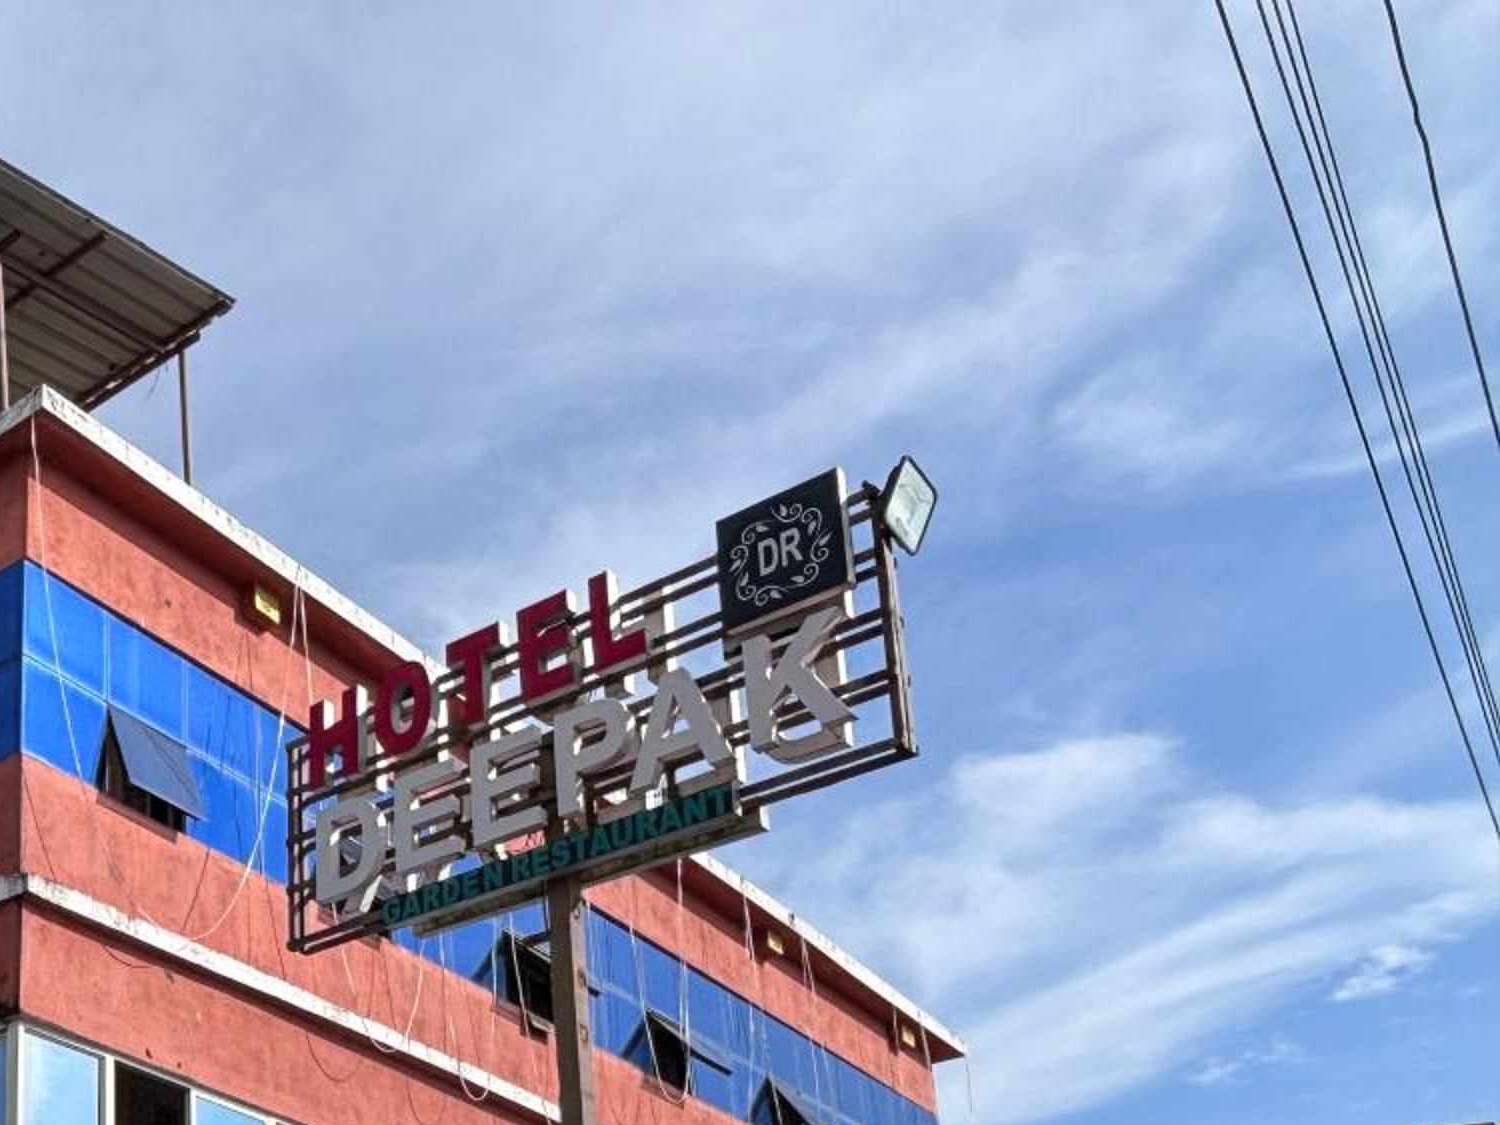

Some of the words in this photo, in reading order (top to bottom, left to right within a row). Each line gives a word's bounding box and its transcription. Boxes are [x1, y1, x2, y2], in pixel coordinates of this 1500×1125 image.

[757, 527, 803, 577] DR
[309, 570, 647, 790] HOTEL
[315, 606, 858, 902] DEEPAK
[381, 859, 508, 924] GARDEN
[508, 782, 734, 881] RESTAURANT
